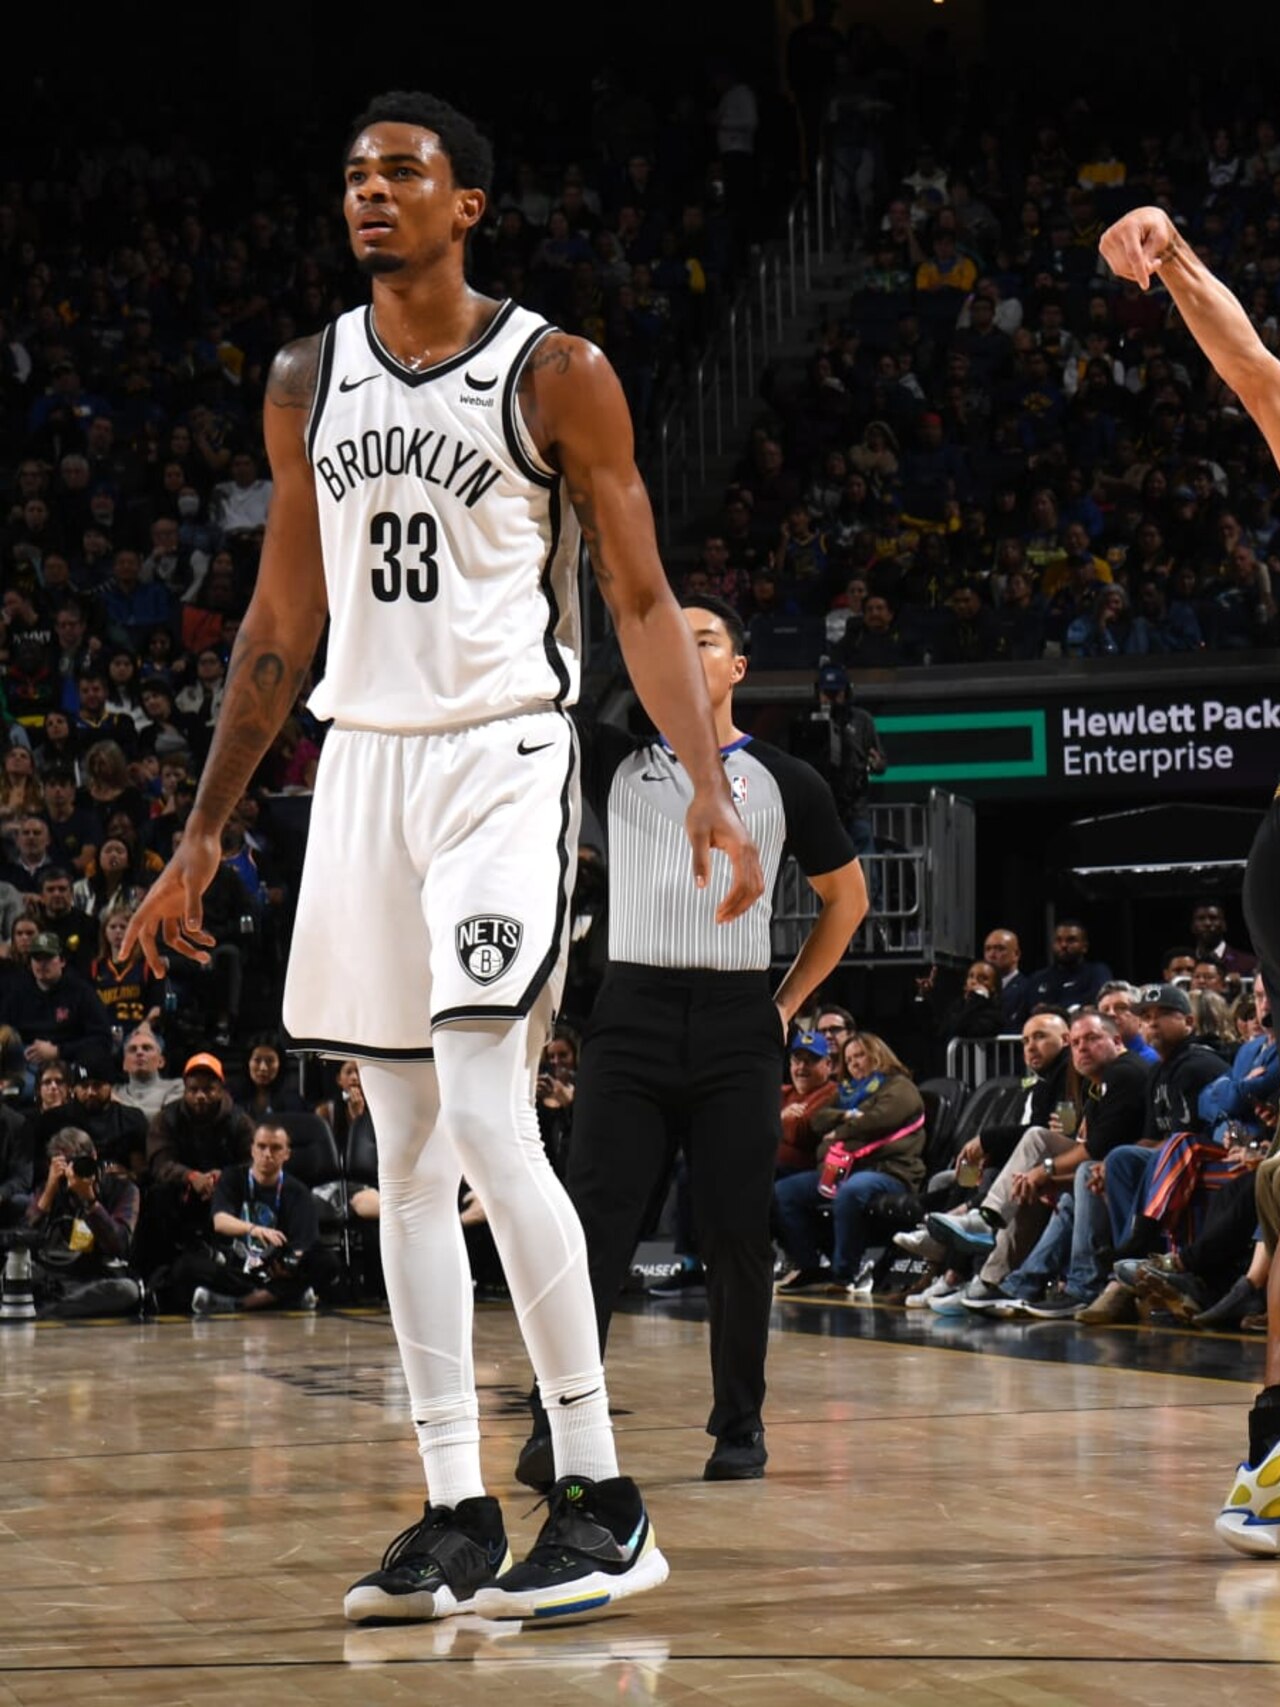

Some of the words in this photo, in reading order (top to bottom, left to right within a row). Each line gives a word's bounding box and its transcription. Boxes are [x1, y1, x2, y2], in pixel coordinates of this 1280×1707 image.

[459, 394, 494, 408] Webull
[317, 427, 502, 508] BROOKLYN
[370, 511, 439, 603] 33
[1062, 704, 1197, 738] Hewlett
[1063, 740, 1235, 779] Enterprise
[459, 919, 518, 950] NETS
[481, 950, 492, 973] B
